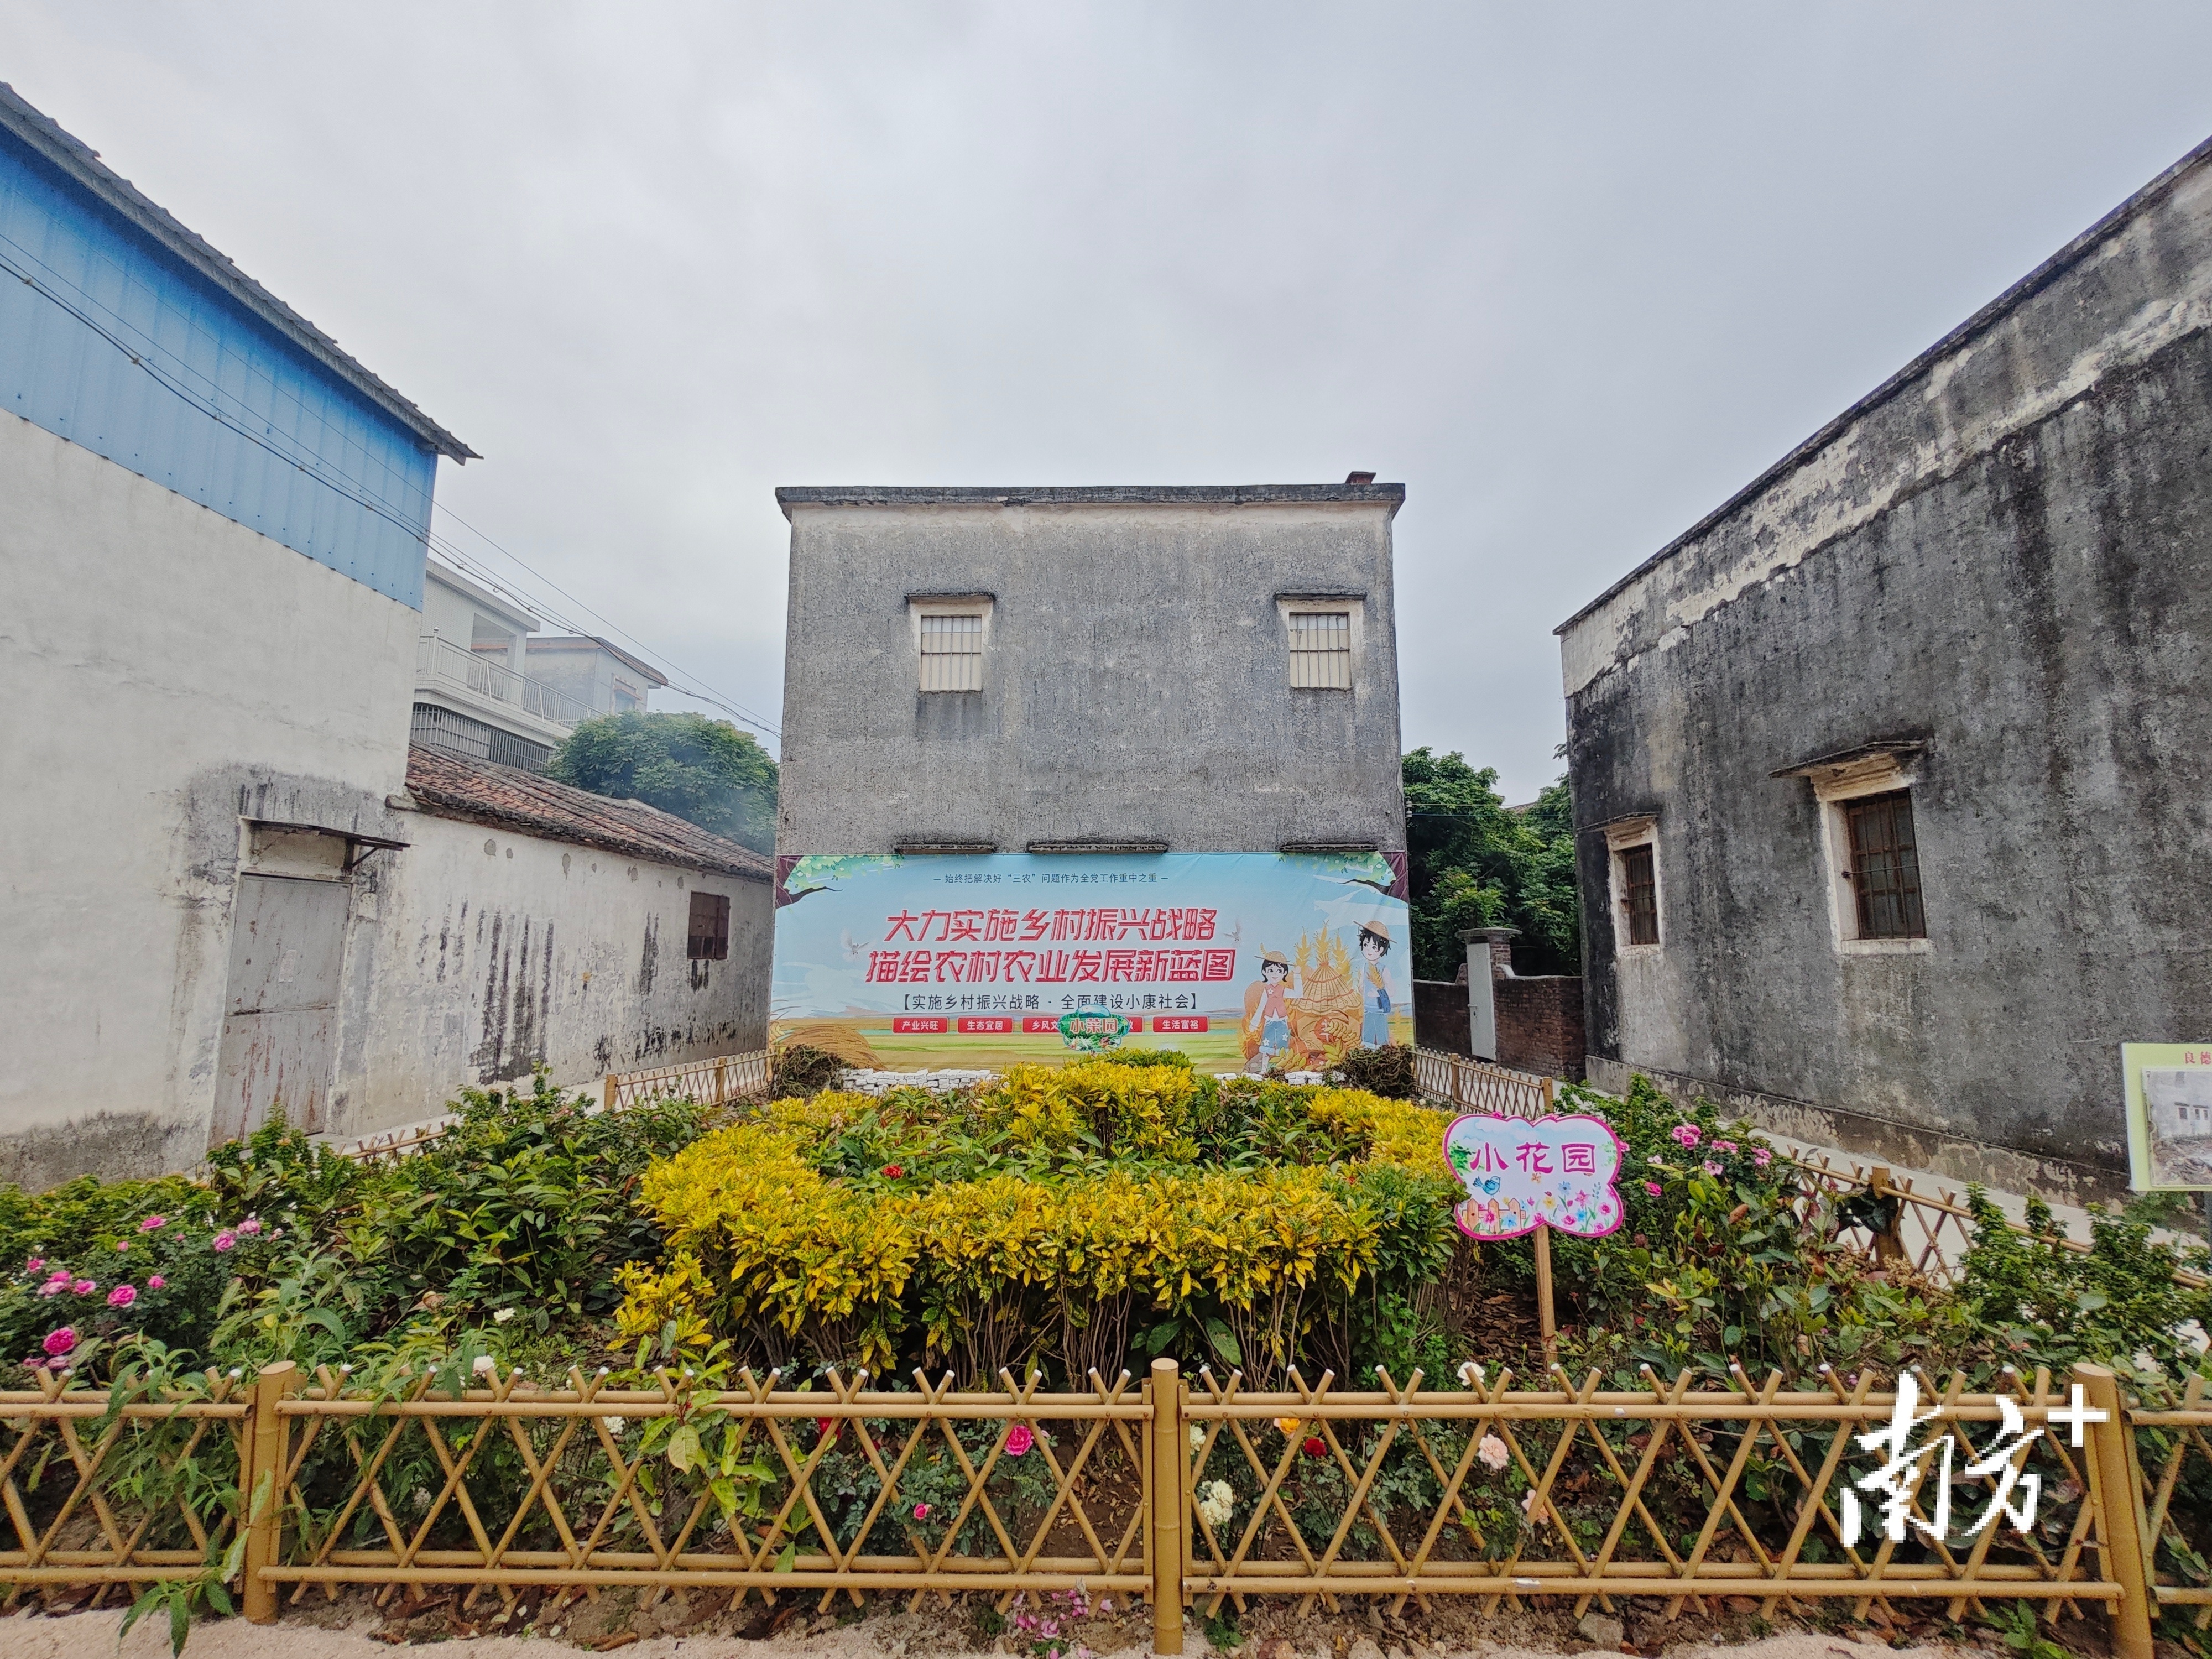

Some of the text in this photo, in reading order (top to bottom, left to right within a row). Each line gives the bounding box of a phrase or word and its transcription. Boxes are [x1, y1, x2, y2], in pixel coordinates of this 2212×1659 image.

[884, 908, 1217, 942] 大力实施乡村振兴战略
[865, 948, 1236, 983] 描绘农村农业发展新蓝图
[901, 1020, 939, 1030] 产业兴旺
[967, 1020, 1003, 1030] 生态宜居
[1069, 1017, 1118, 1034] 小菜园
[1162, 1019, 1199, 1030] 生活富裕
[1469, 1142, 1596, 1173] 小花园
